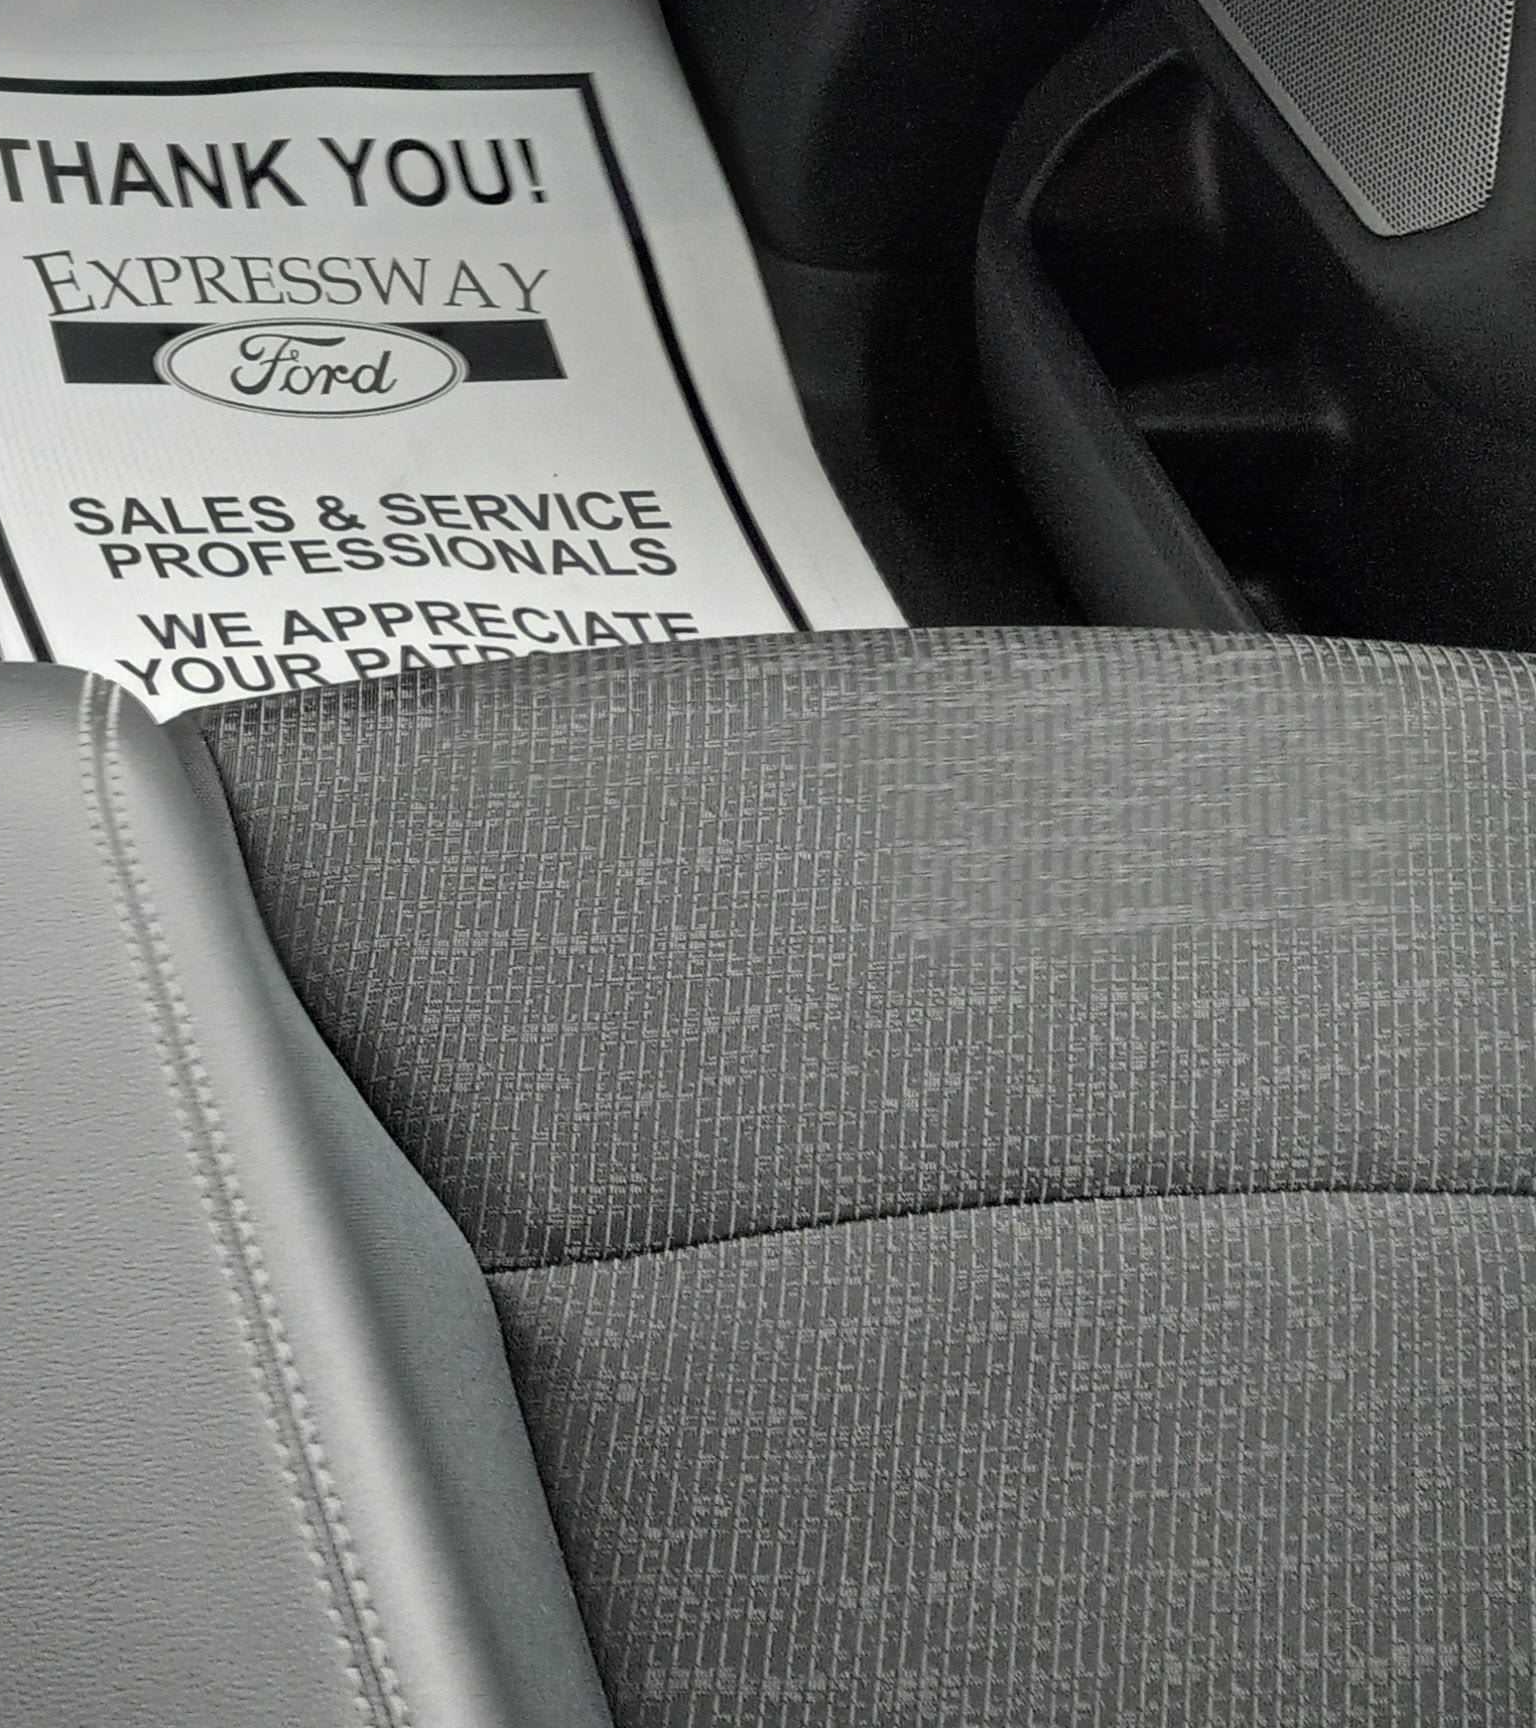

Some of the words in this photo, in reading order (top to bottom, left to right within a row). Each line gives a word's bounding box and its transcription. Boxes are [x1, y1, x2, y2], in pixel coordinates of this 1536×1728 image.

[318, 136, 551, 208] YOU!
[23, 249, 551, 318] EXPRESSWAY
[229, 333, 398, 397] Ford
[68, 494, 296, 537] SALES
[314, 493, 362, 534] &
[378, 489, 674, 533] SERVICE
[99, 536, 680, 581] PROFESSIONALS
[137, 611, 265, 651] WE
[282, 599, 701, 648] APPRECIATE
[115, 652, 326, 697] YOUR
